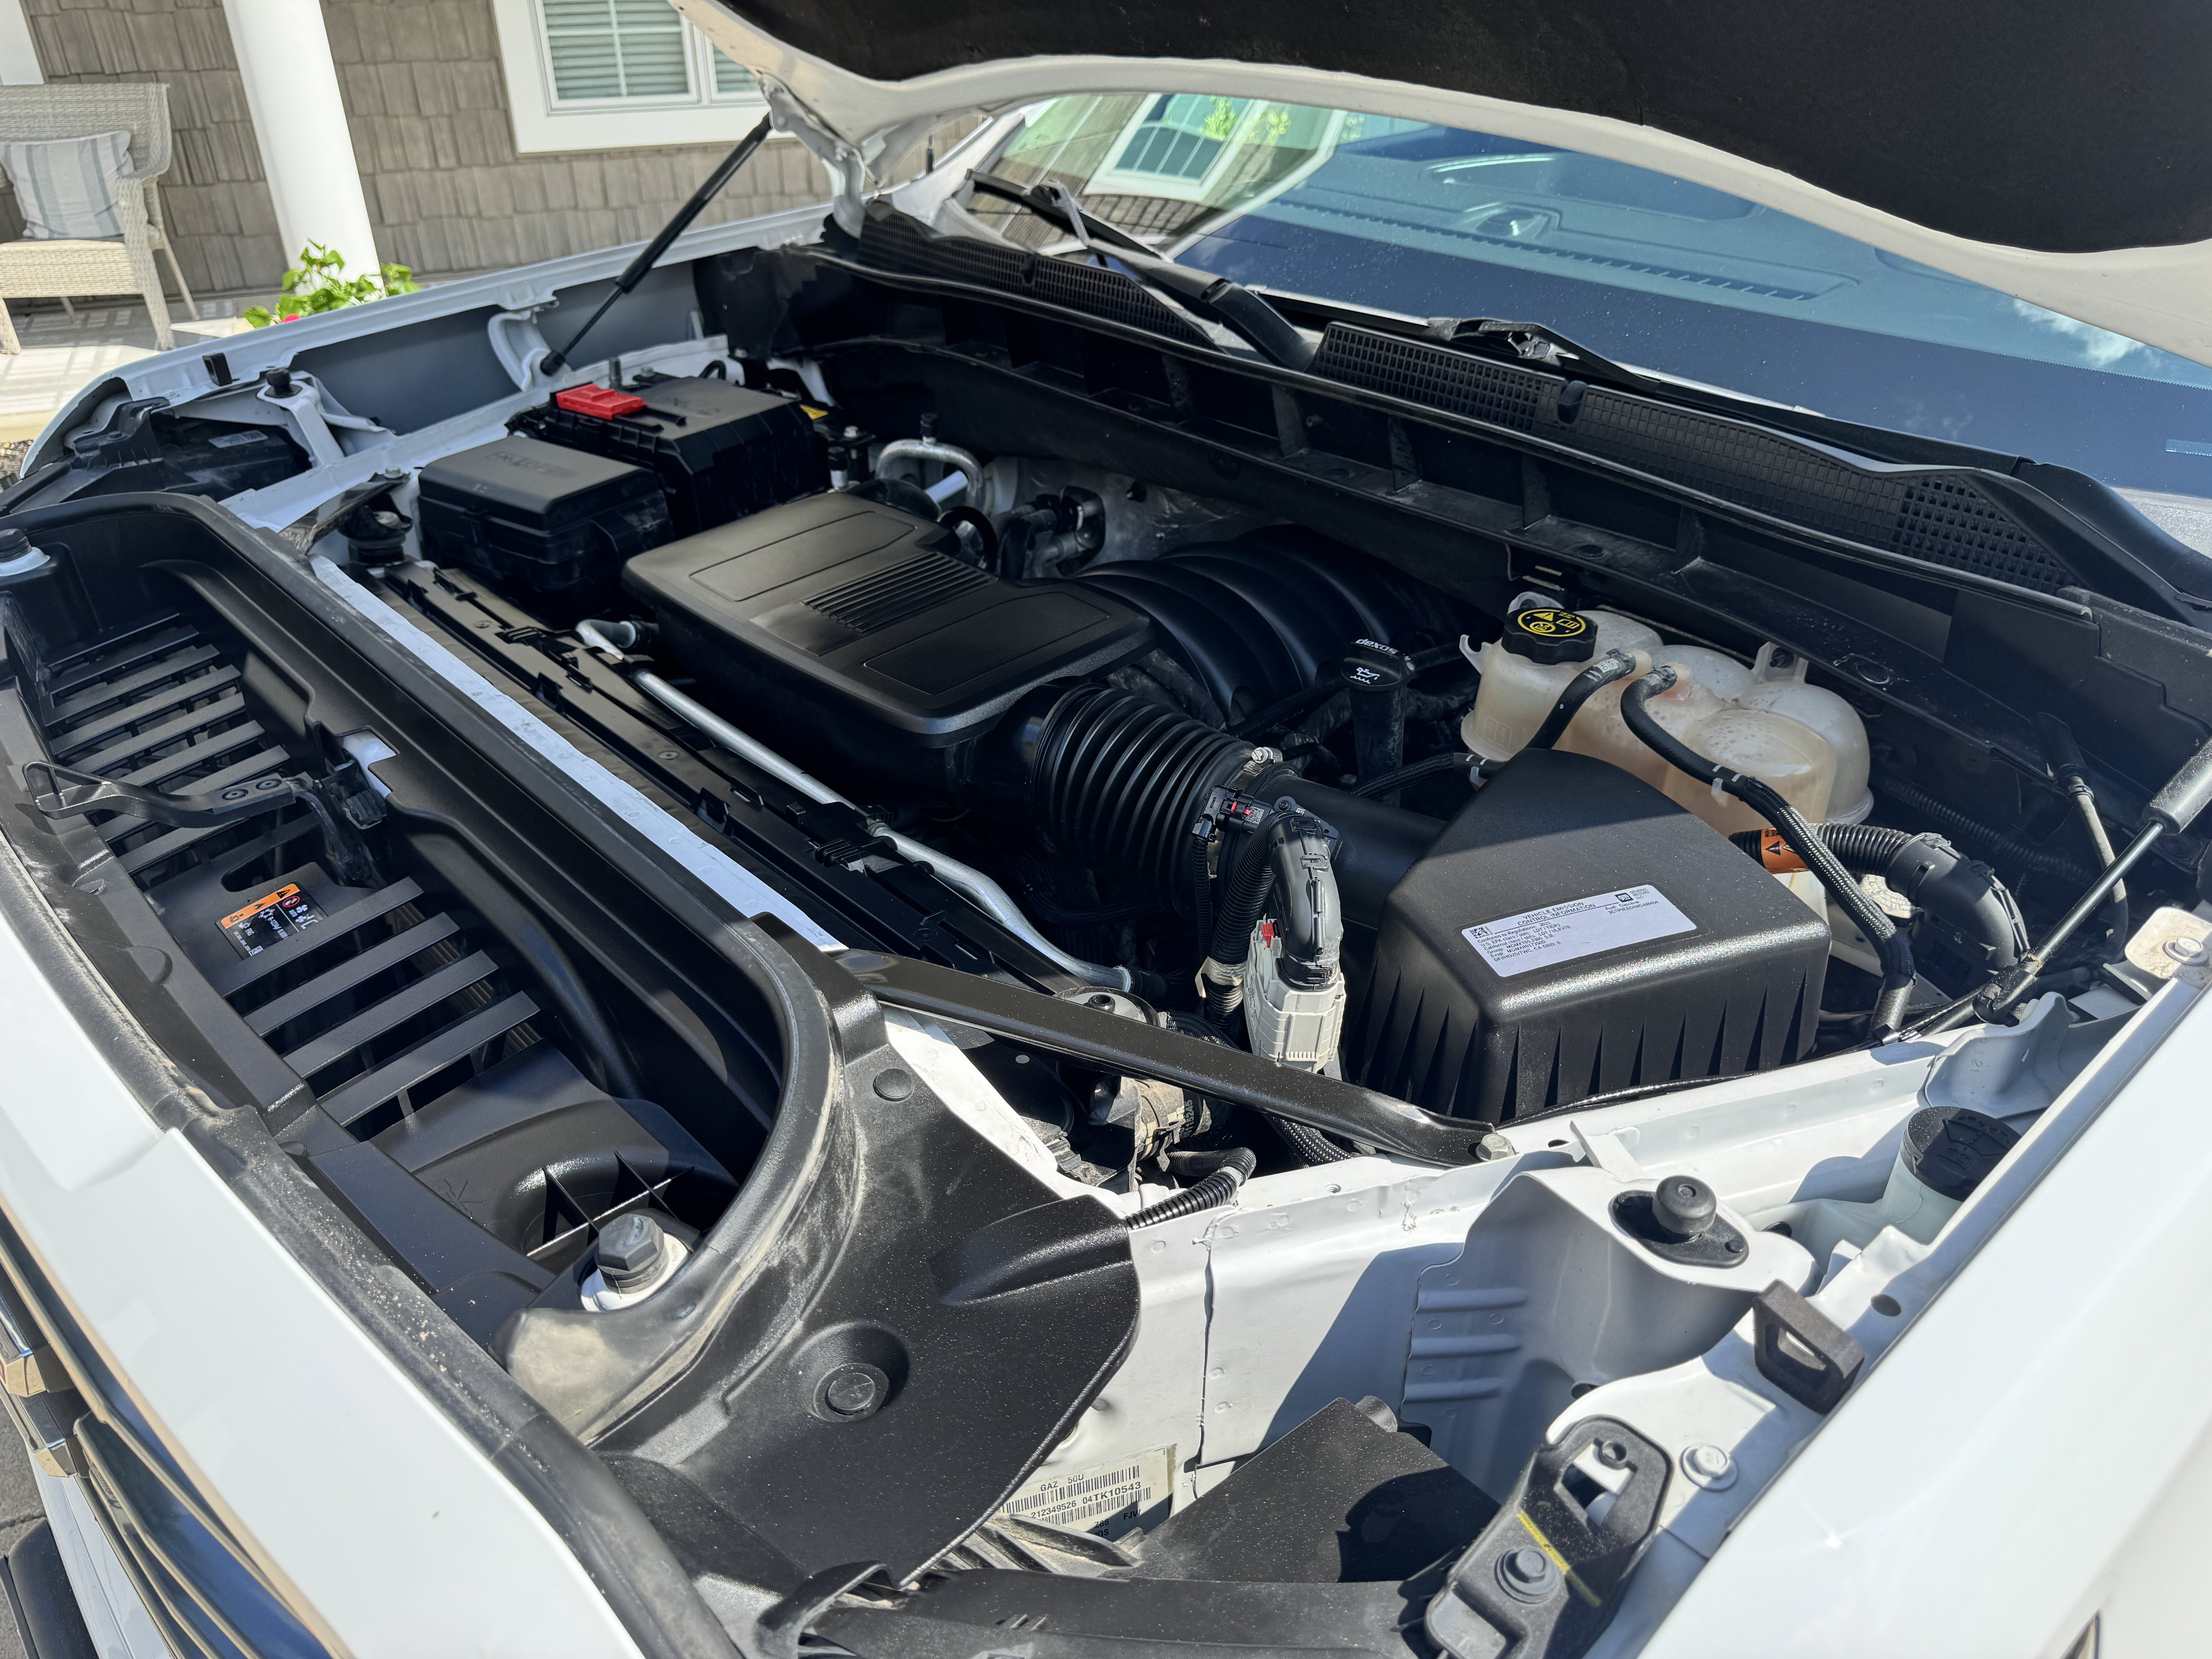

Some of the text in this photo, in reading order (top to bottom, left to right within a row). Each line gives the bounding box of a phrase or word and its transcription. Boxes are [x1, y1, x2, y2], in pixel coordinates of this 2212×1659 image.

[1355, 639, 1398, 654] dexos
[1518, 903, 1596, 926] CONTROL INFORMATION
[1523, 902, 1584, 920] VEHICLE EMISSION
[1477, 935, 1501, 943] Conforms
[1507, 925, 1537, 935] Regulations:
[1484, 942, 1508, 950] California
[1041, 1480, 1058, 1491] GAZ
[1031, 1482, 1141, 1518] 212349526 04TK10543
[1094, 1509, 1141, 1528] Z88 FJW
